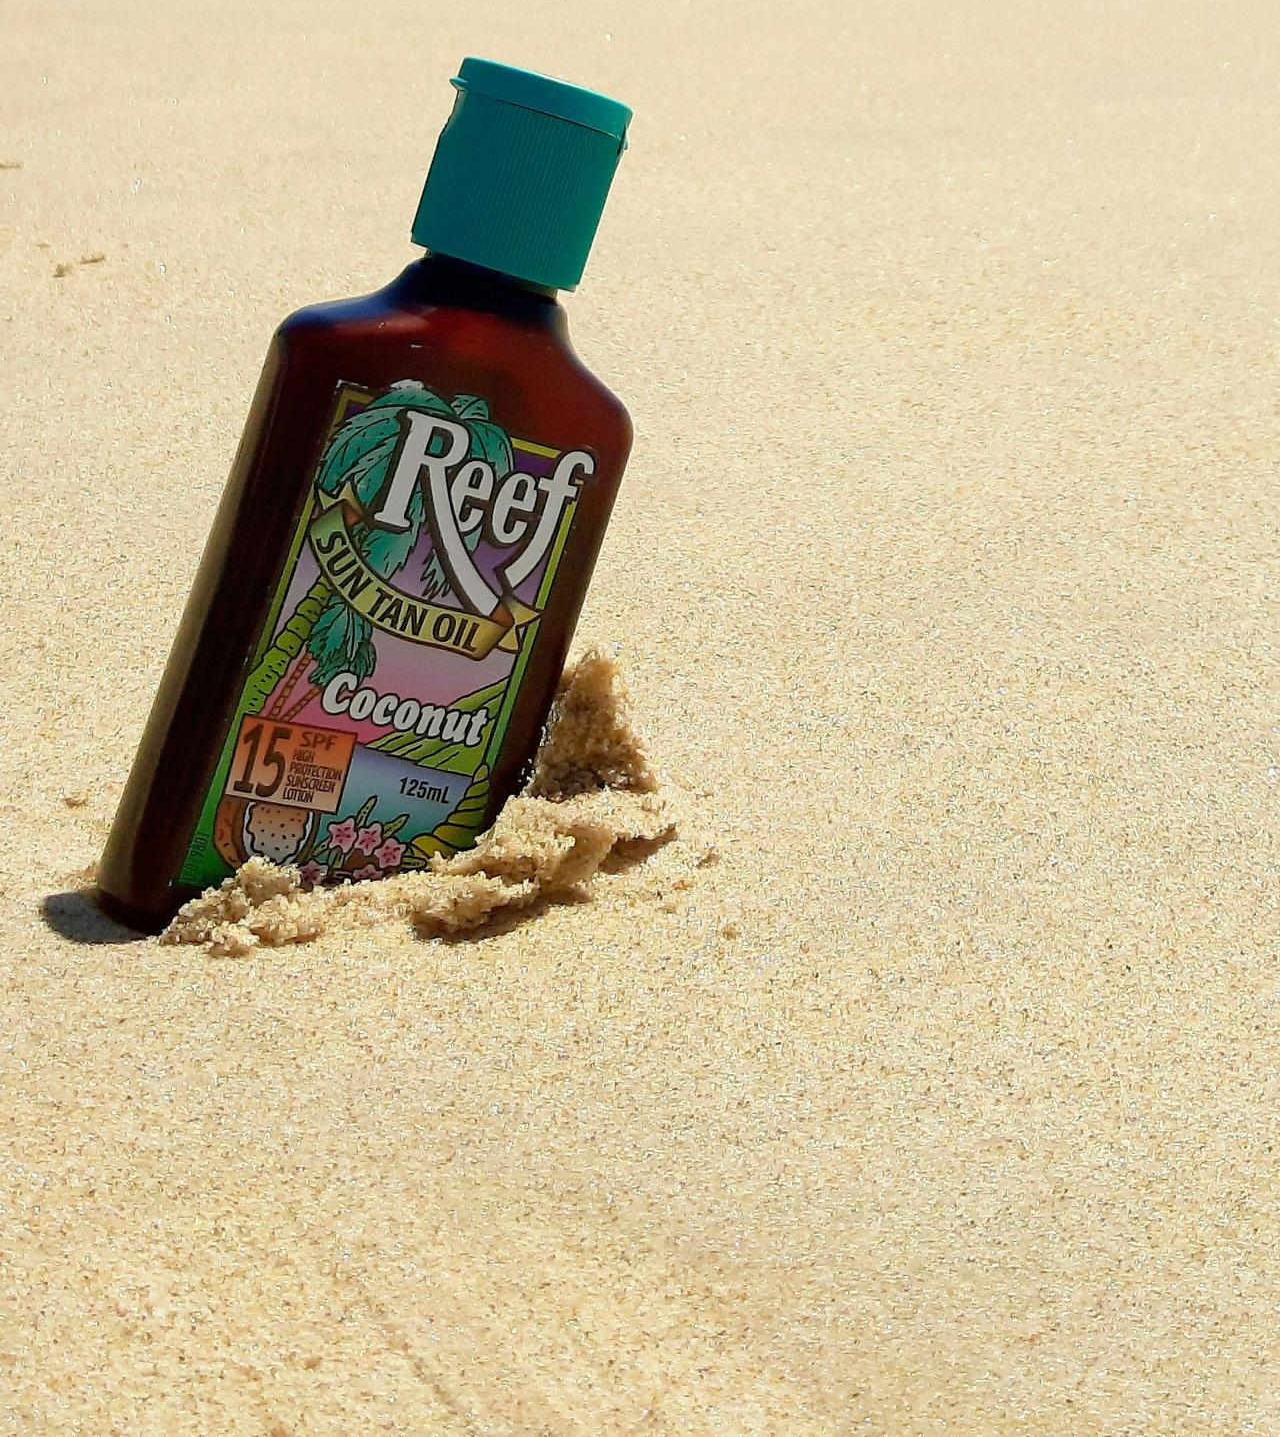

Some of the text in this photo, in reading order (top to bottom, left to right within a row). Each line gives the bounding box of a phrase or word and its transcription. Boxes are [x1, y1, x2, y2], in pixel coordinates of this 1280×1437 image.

[374, 411, 595, 616] Reef
[317, 531, 480, 652] SUN TAN OIL
[321, 672, 488, 746] Coconut
[300, 731, 338, 750] SPF
[233, 723, 292, 797] 15
[289, 762, 343, 781] PROTECTION
[282, 789, 314, 802] LOTION
[285, 775, 336, 794] SUNSCREEN
[399, 776, 450, 804] 125mL
